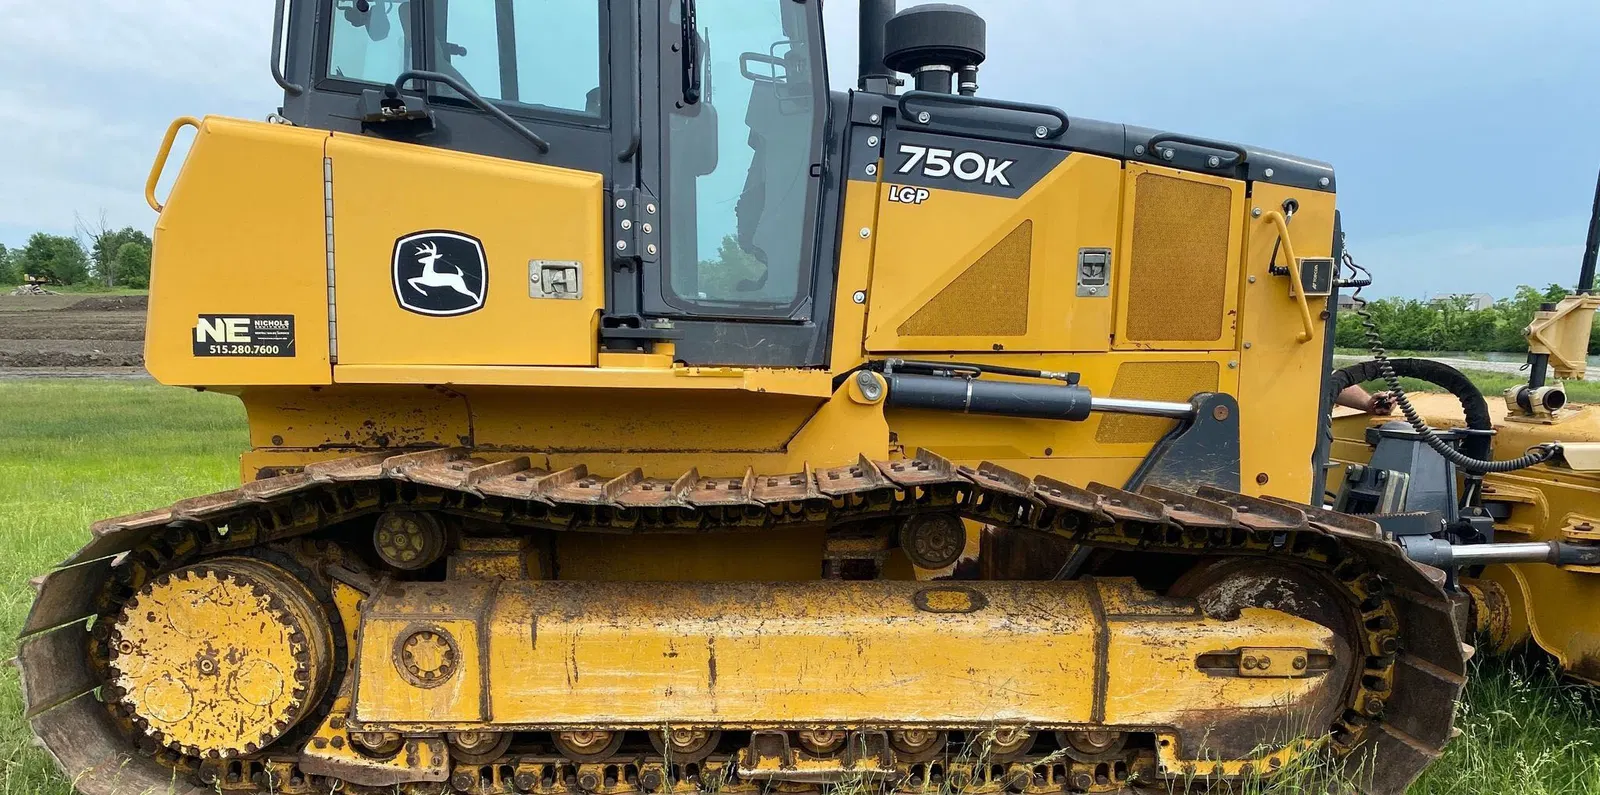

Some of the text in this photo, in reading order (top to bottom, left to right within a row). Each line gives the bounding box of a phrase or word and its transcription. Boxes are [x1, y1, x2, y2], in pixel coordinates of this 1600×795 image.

[897, 144, 1014, 187] 750K
[889, 186, 929, 204] LGP
[196, 317, 251, 343] NE
[209, 345, 279, 354] 515.280.7600
